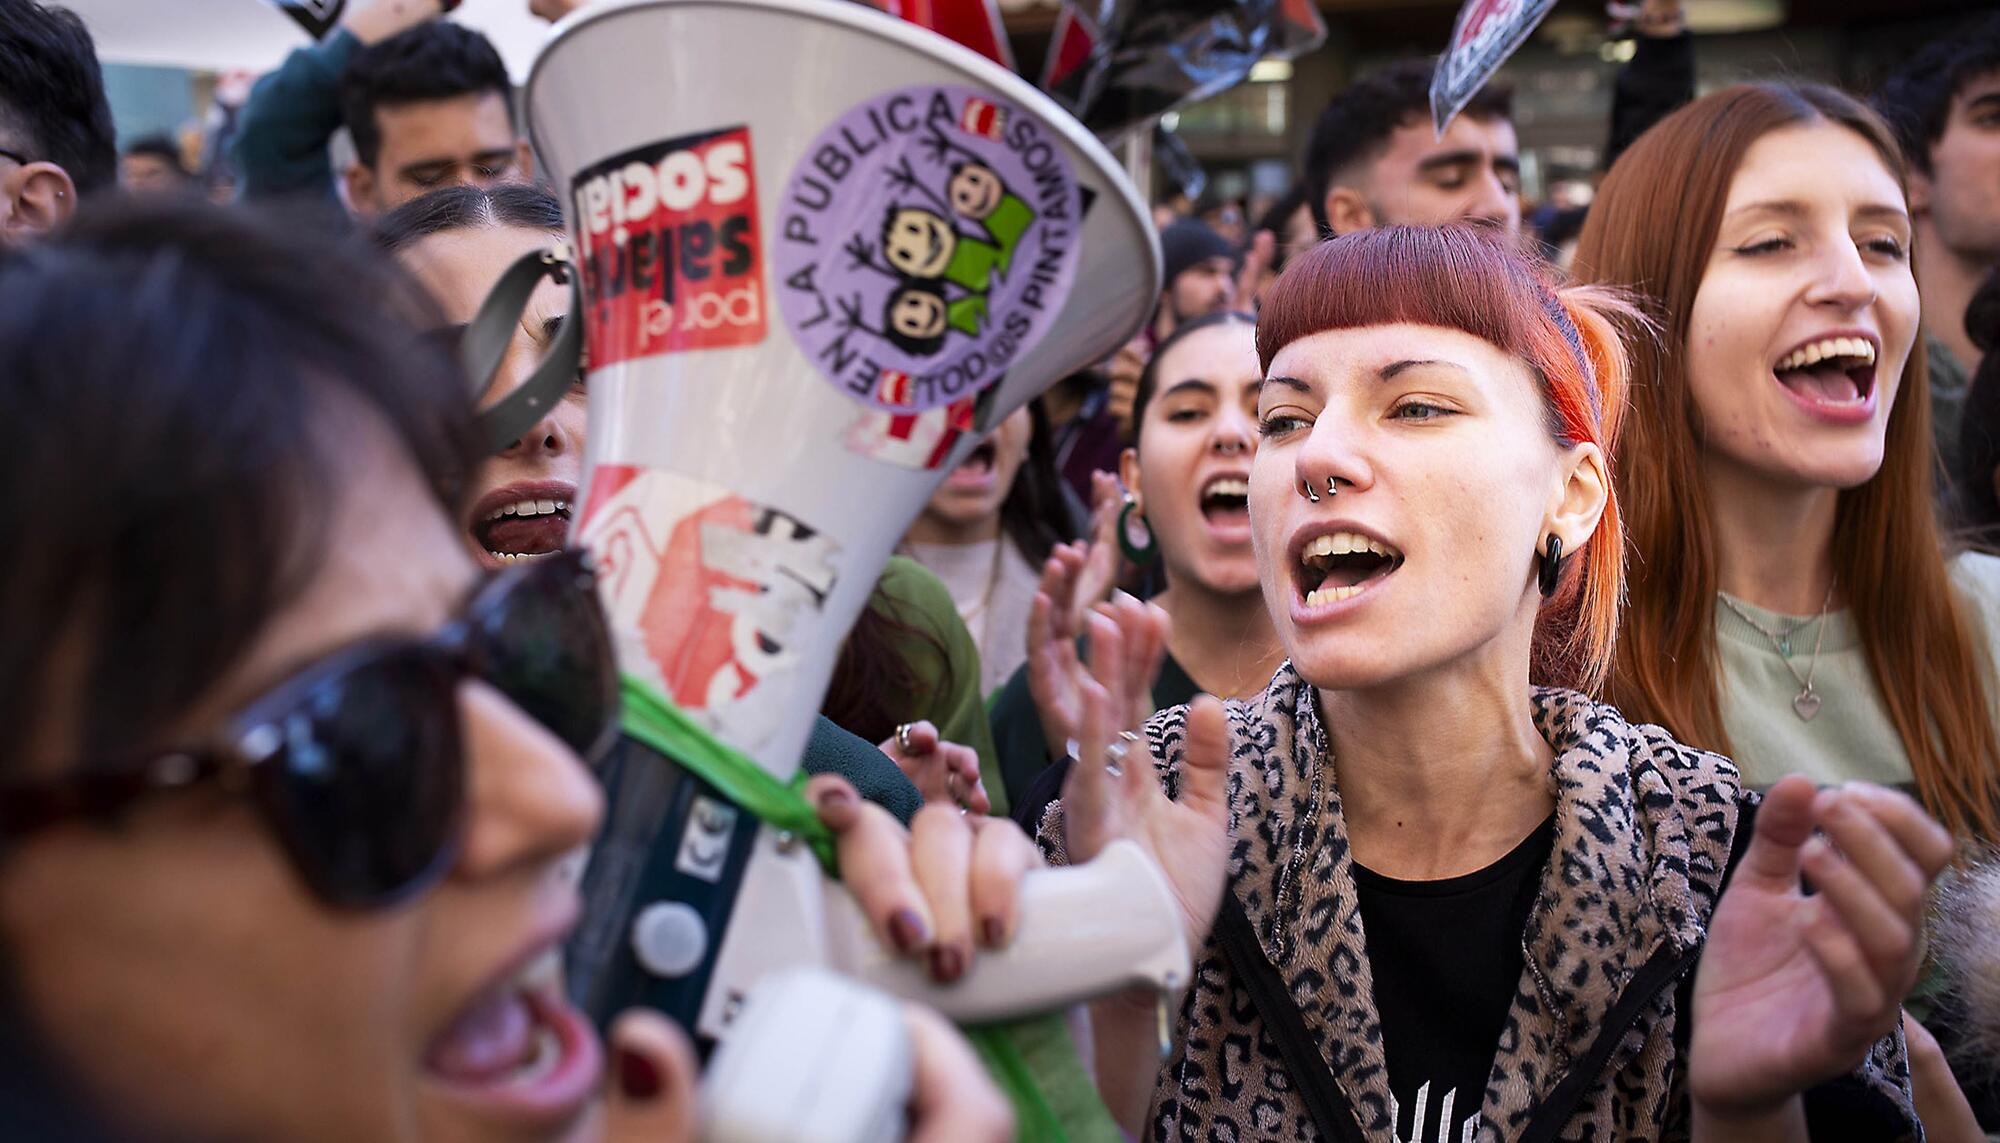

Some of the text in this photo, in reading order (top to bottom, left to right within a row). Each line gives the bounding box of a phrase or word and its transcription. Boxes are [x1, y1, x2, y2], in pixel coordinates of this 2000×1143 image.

[576, 141, 749, 258] social
[784, 89, 955, 396] EN LA PUBLICA
[915, 310, 1032, 402] TOD@S
[1005, 118, 1070, 311] PINTAMOS
[638, 279, 760, 348] por el
